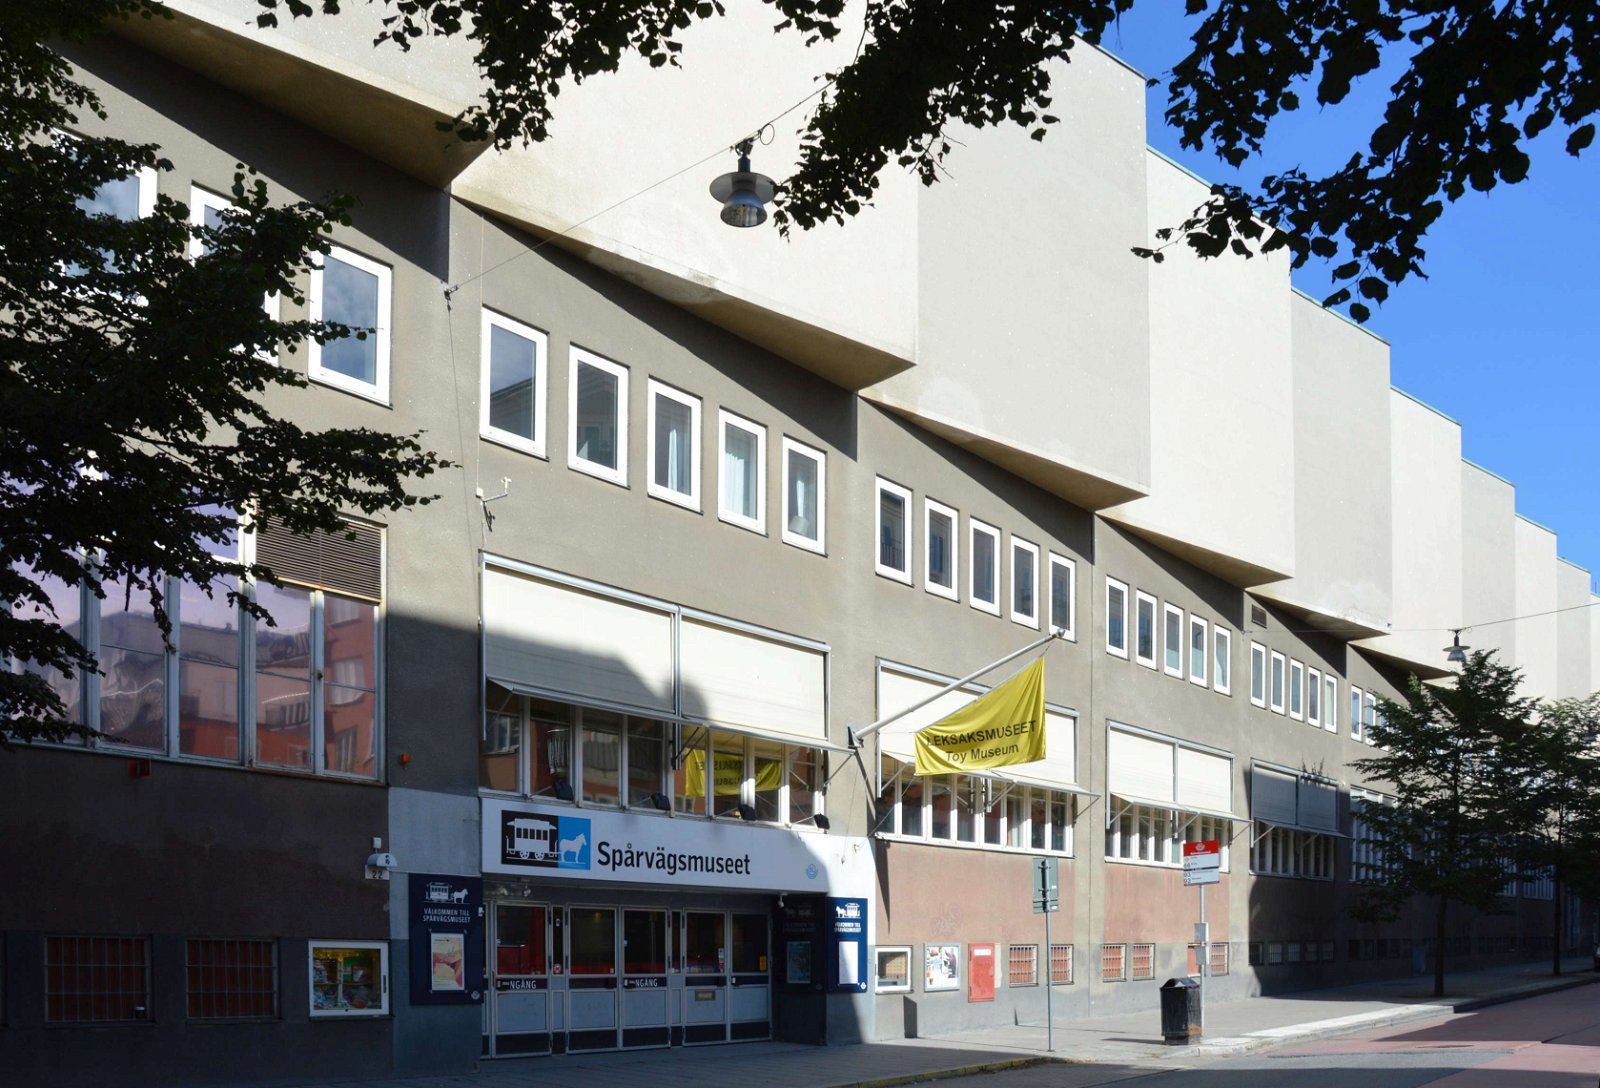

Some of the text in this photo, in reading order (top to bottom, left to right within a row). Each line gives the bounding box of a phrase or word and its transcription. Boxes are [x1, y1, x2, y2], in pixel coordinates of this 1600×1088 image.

[926, 720, 1037, 747] LEKSAKSMUSEET
[946, 743, 1019, 764] Toy Museum
[597, 841, 751, 876] Spårvägsmuseet
[510, 978, 537, 990] NGÅNG
[635, 976, 658, 988] NGÅNG
